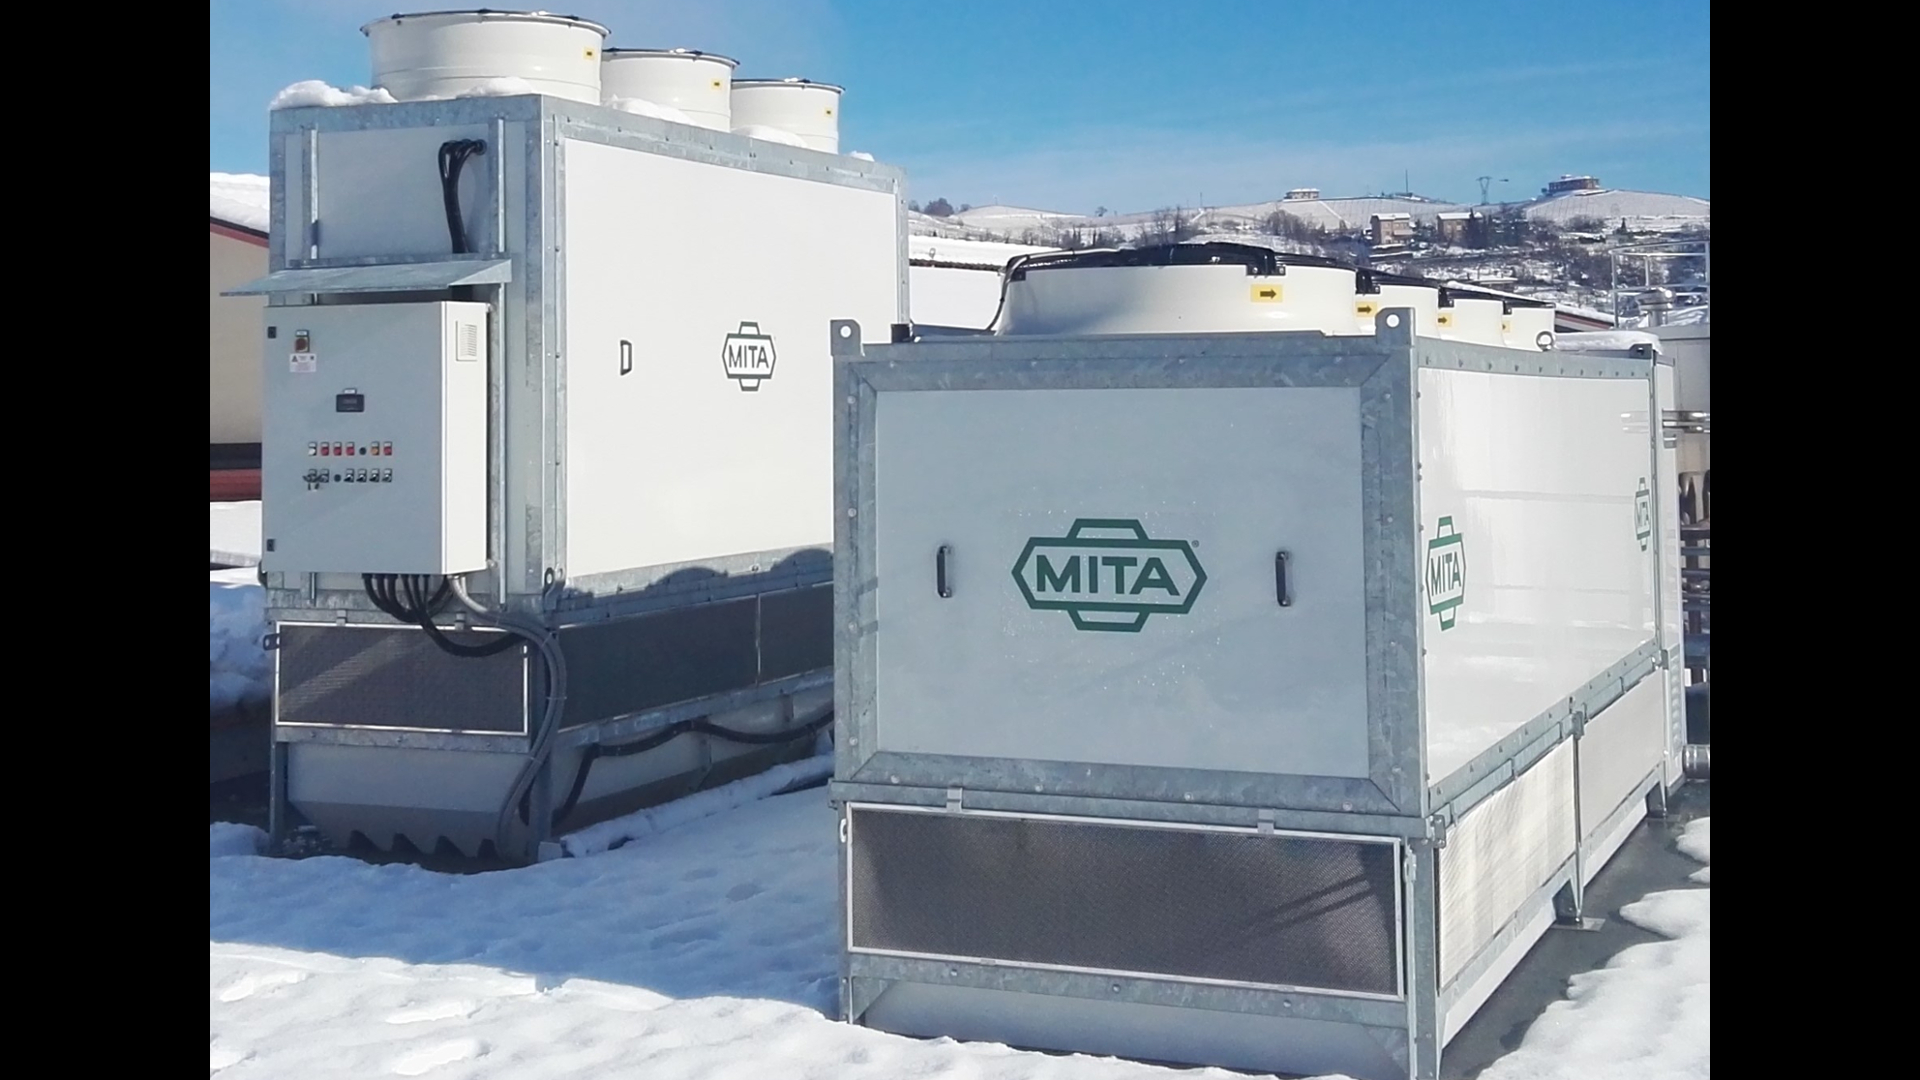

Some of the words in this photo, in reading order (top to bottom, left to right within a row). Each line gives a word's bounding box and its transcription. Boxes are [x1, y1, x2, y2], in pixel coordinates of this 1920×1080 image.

[729, 344, 769, 369] MITA
[1036, 554, 1180, 596] MITA
[1430, 551, 1461, 597] MITA
